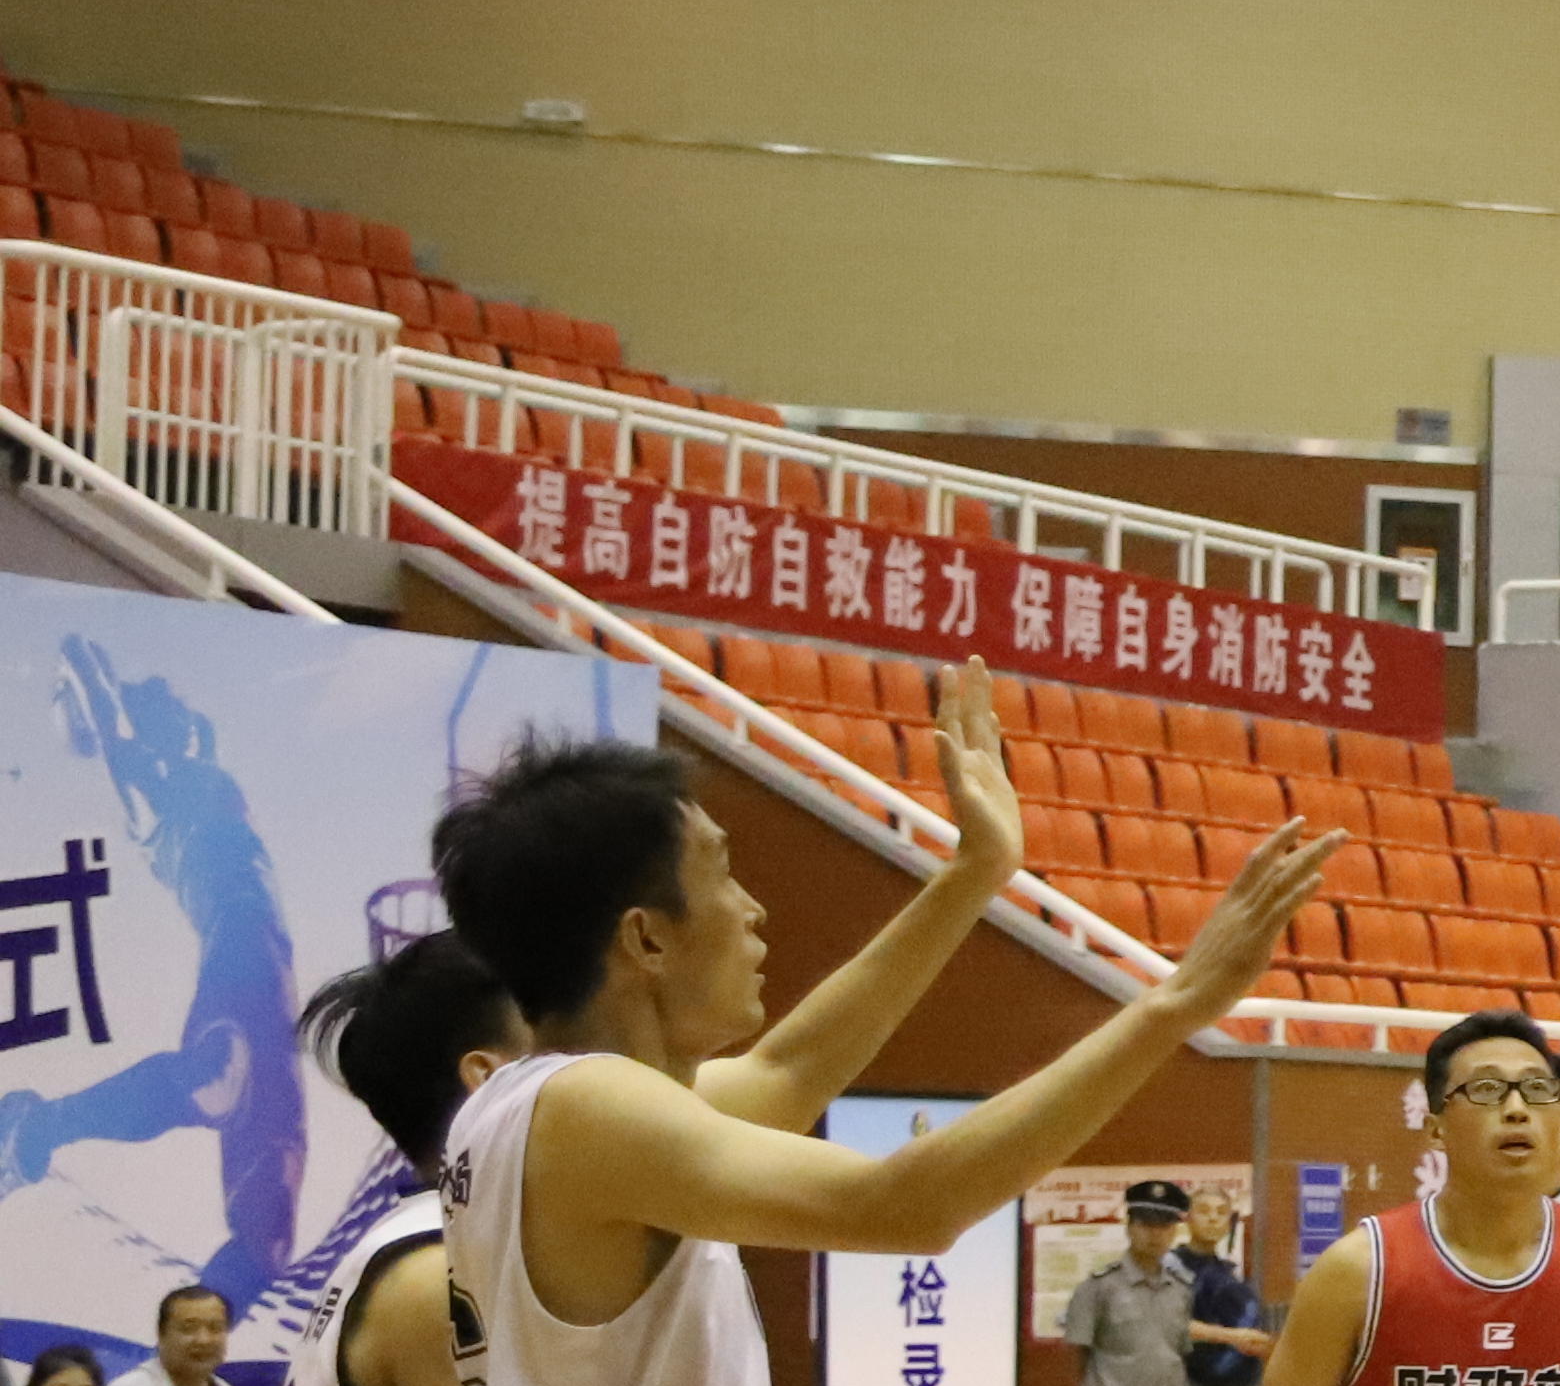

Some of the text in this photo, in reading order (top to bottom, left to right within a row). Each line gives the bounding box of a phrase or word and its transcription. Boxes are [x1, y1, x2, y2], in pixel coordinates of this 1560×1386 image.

[517, 464, 1376, 712] 提高自防自救能力 保障自身消防安全
